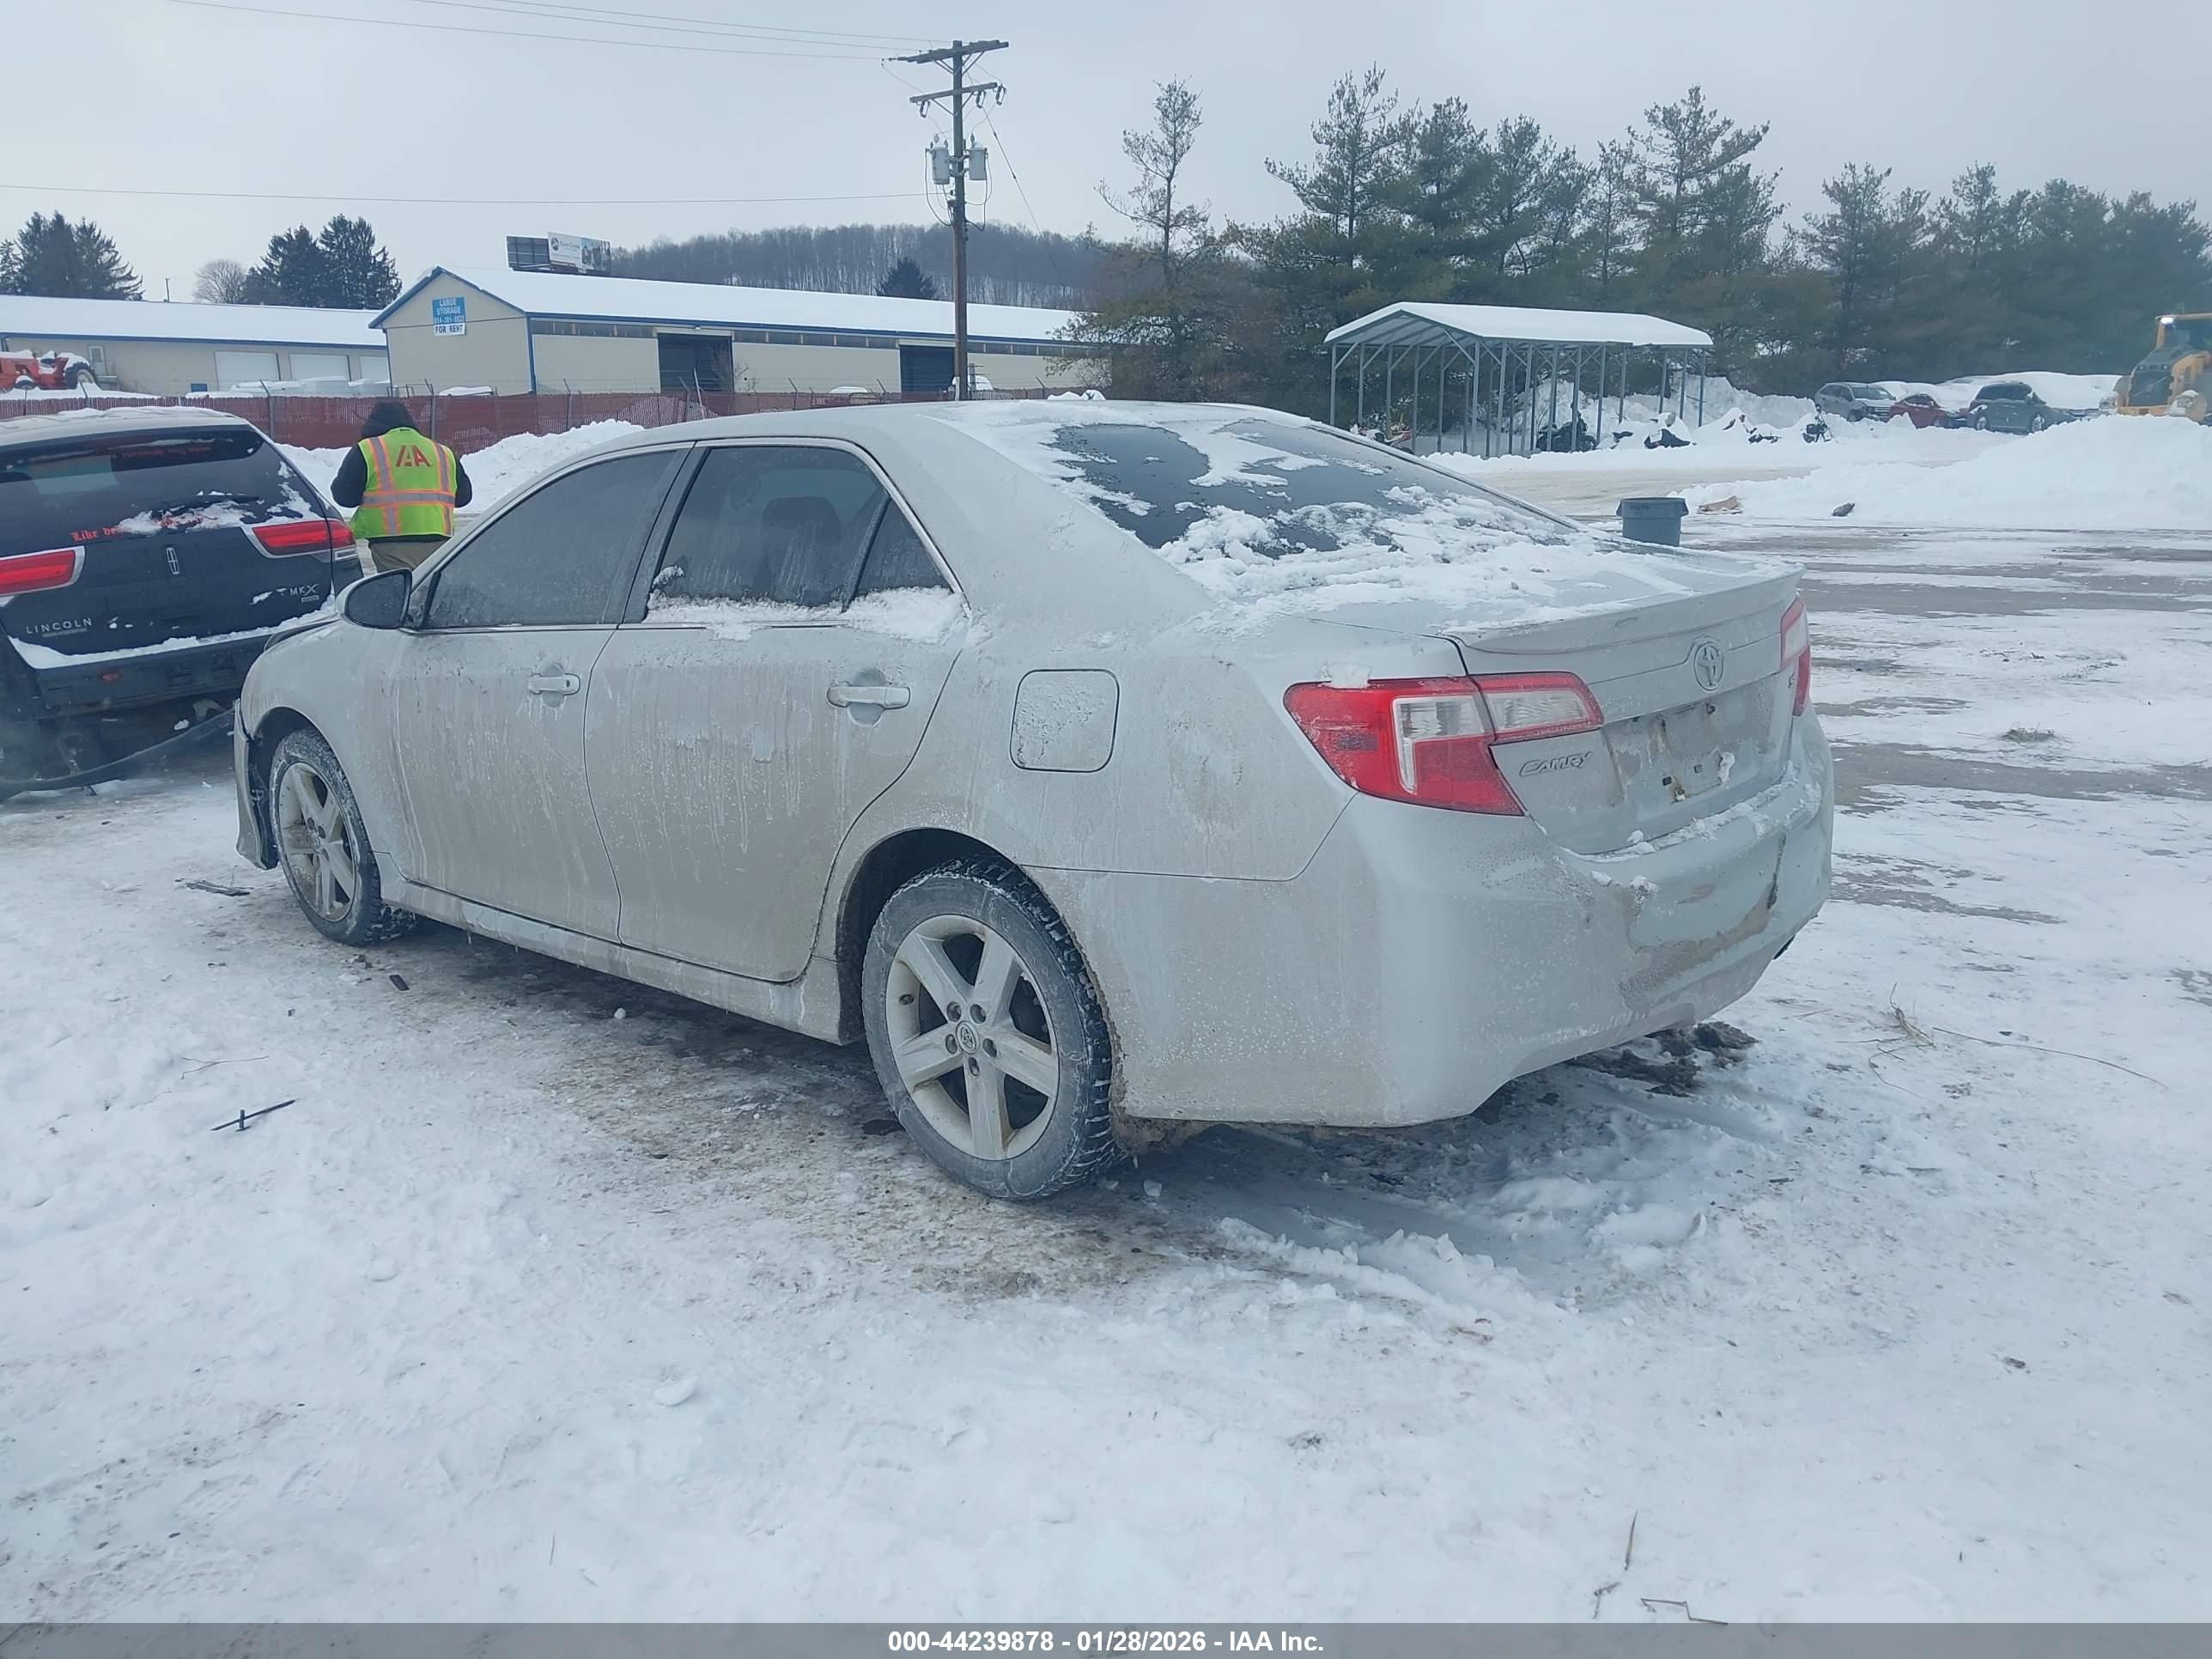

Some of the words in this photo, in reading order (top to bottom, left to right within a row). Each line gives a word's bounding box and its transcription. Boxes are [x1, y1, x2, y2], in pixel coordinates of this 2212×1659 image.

[436, 306, 461, 315] STORAGE
[435, 325, 447, 334] FOR
[449, 324, 463, 333] RENT
[288, 582, 319, 597] MKX
[26, 617, 92, 634] LINCOLN
[1518, 750, 1593, 776] CAMRY
